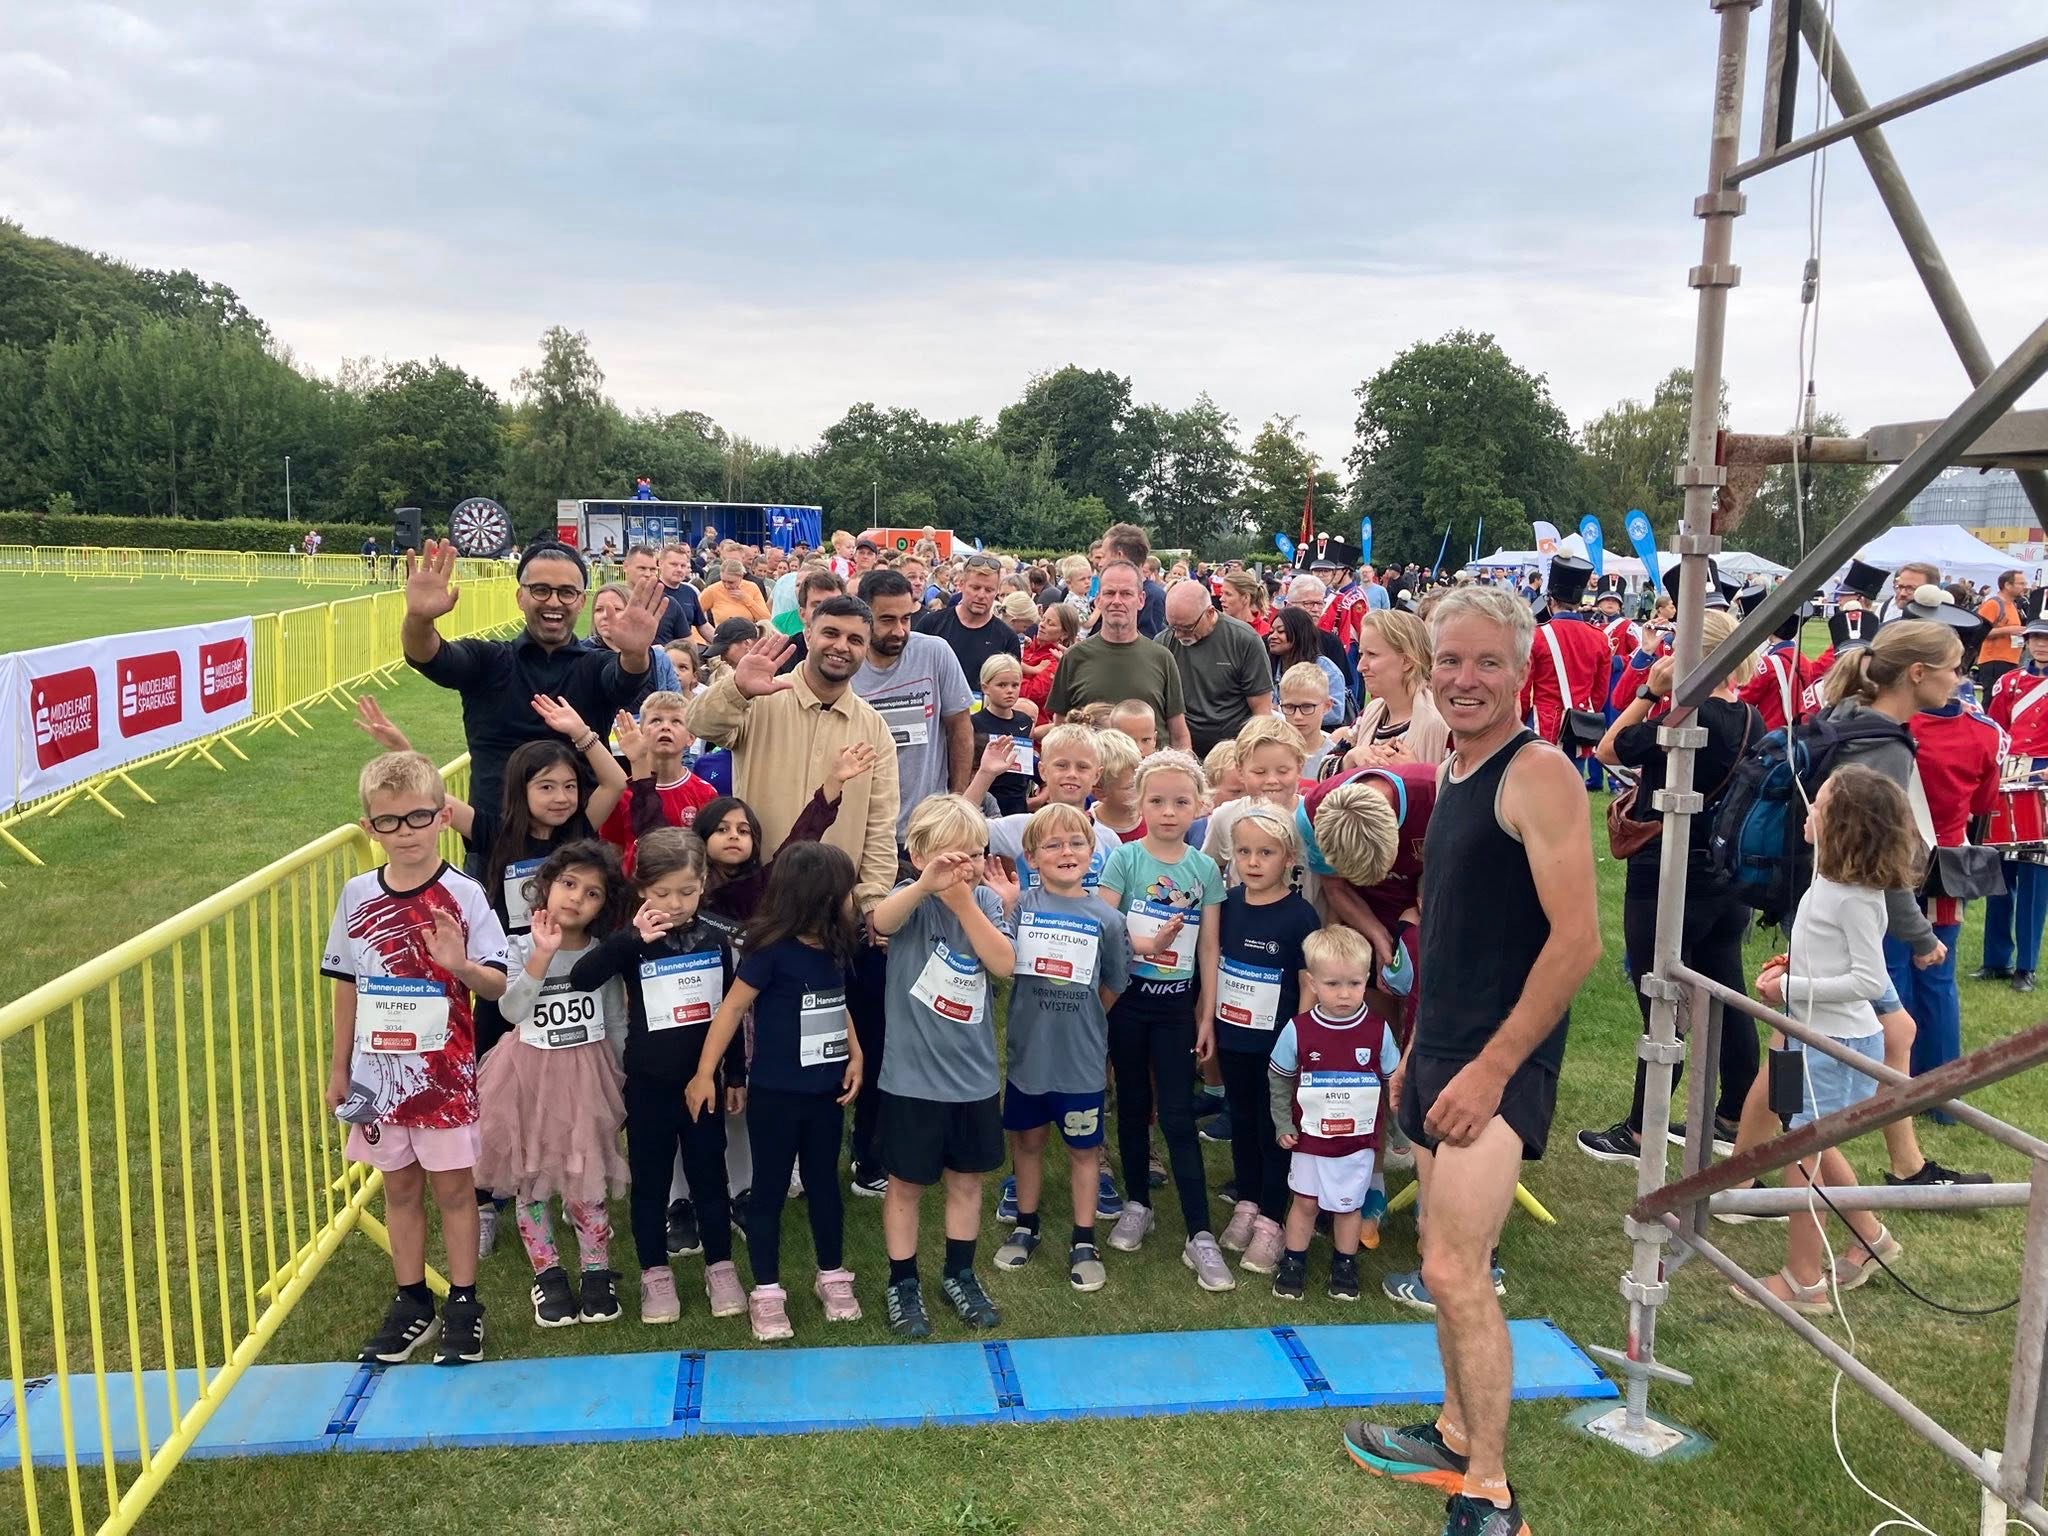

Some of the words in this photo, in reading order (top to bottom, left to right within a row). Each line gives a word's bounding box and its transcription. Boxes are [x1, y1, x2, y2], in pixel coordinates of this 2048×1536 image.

[215, 658, 244, 678] MIDDELFART
[138, 675, 176, 697] MIDDELFART
[215, 671, 244, 692] SPAREKASSE
[50, 695, 92, 722] MIDDELFART
[138, 690, 176, 713] SPAREKASSE
[51, 713, 92, 741] SPAREKASSE
[1083, 923, 1098, 933] 2025
[1028, 931, 1050, 940] OTTO
[1051, 932, 1088, 946] KLITLUND
[678, 976, 702, 985] ROSA
[1263, 972, 1279, 981] 2025
[1141, 980, 1187, 994] NIKE
[1225, 979, 1256, 993] ALBERTE
[375, 1001, 417, 1011] WILFRED
[533, 996, 595, 1028] 5050
[1325, 1092, 1350, 1100] ARVID
